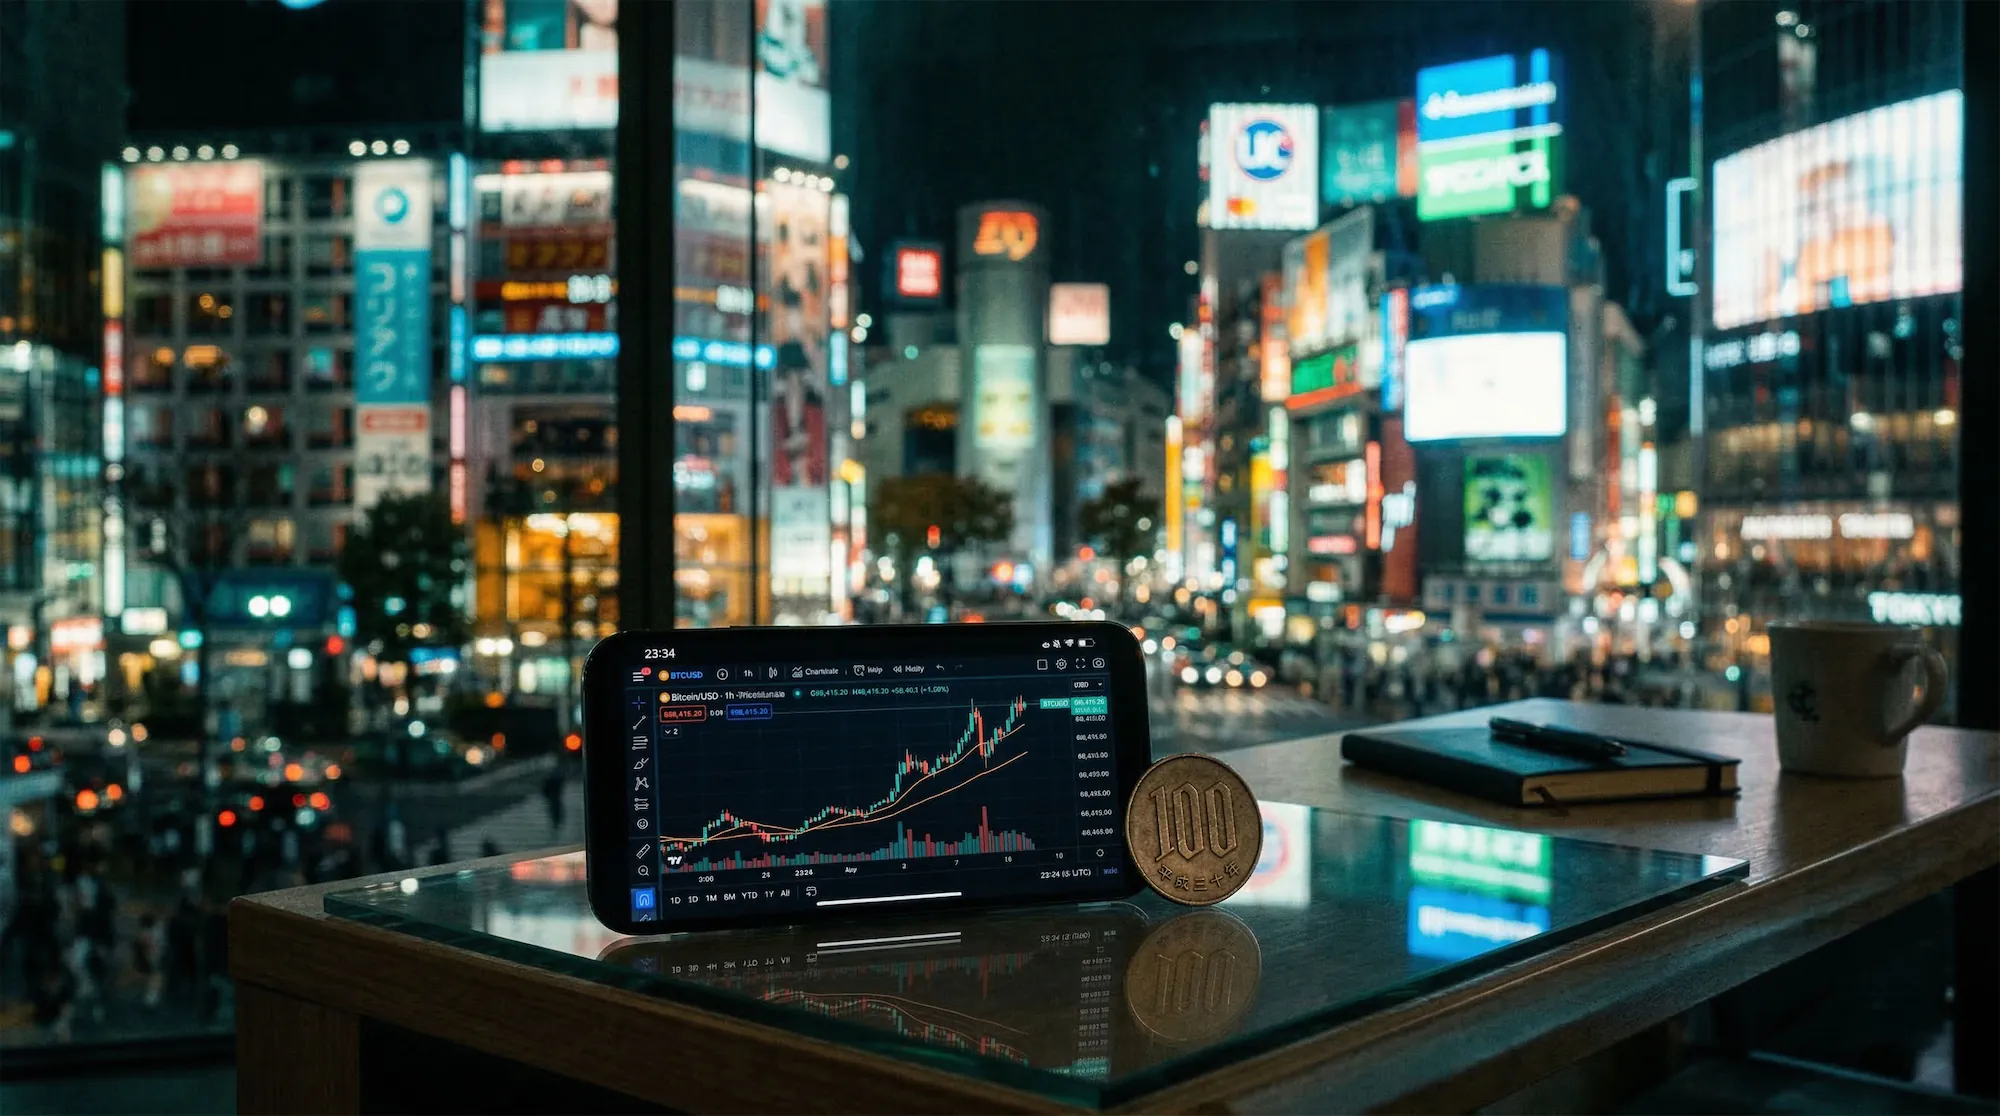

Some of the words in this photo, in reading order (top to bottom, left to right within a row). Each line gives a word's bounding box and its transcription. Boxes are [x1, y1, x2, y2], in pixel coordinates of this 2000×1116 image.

[644, 648, 676, 660] 23:34
[670, 670, 704, 680] BTCUSD
[743, 669, 754, 678] 1h
[673, 727, 679, 736] 2
[1150, 781, 1237, 862] 100
[1158, 860, 1241, 891] 平成三十年
[705, 894, 718, 902] 1M
[741, 890, 758, 900] YTD
[764, 890, 775, 899] 1Y
[780, 888, 791, 898] All
[670, 896, 682, 905] 1D
